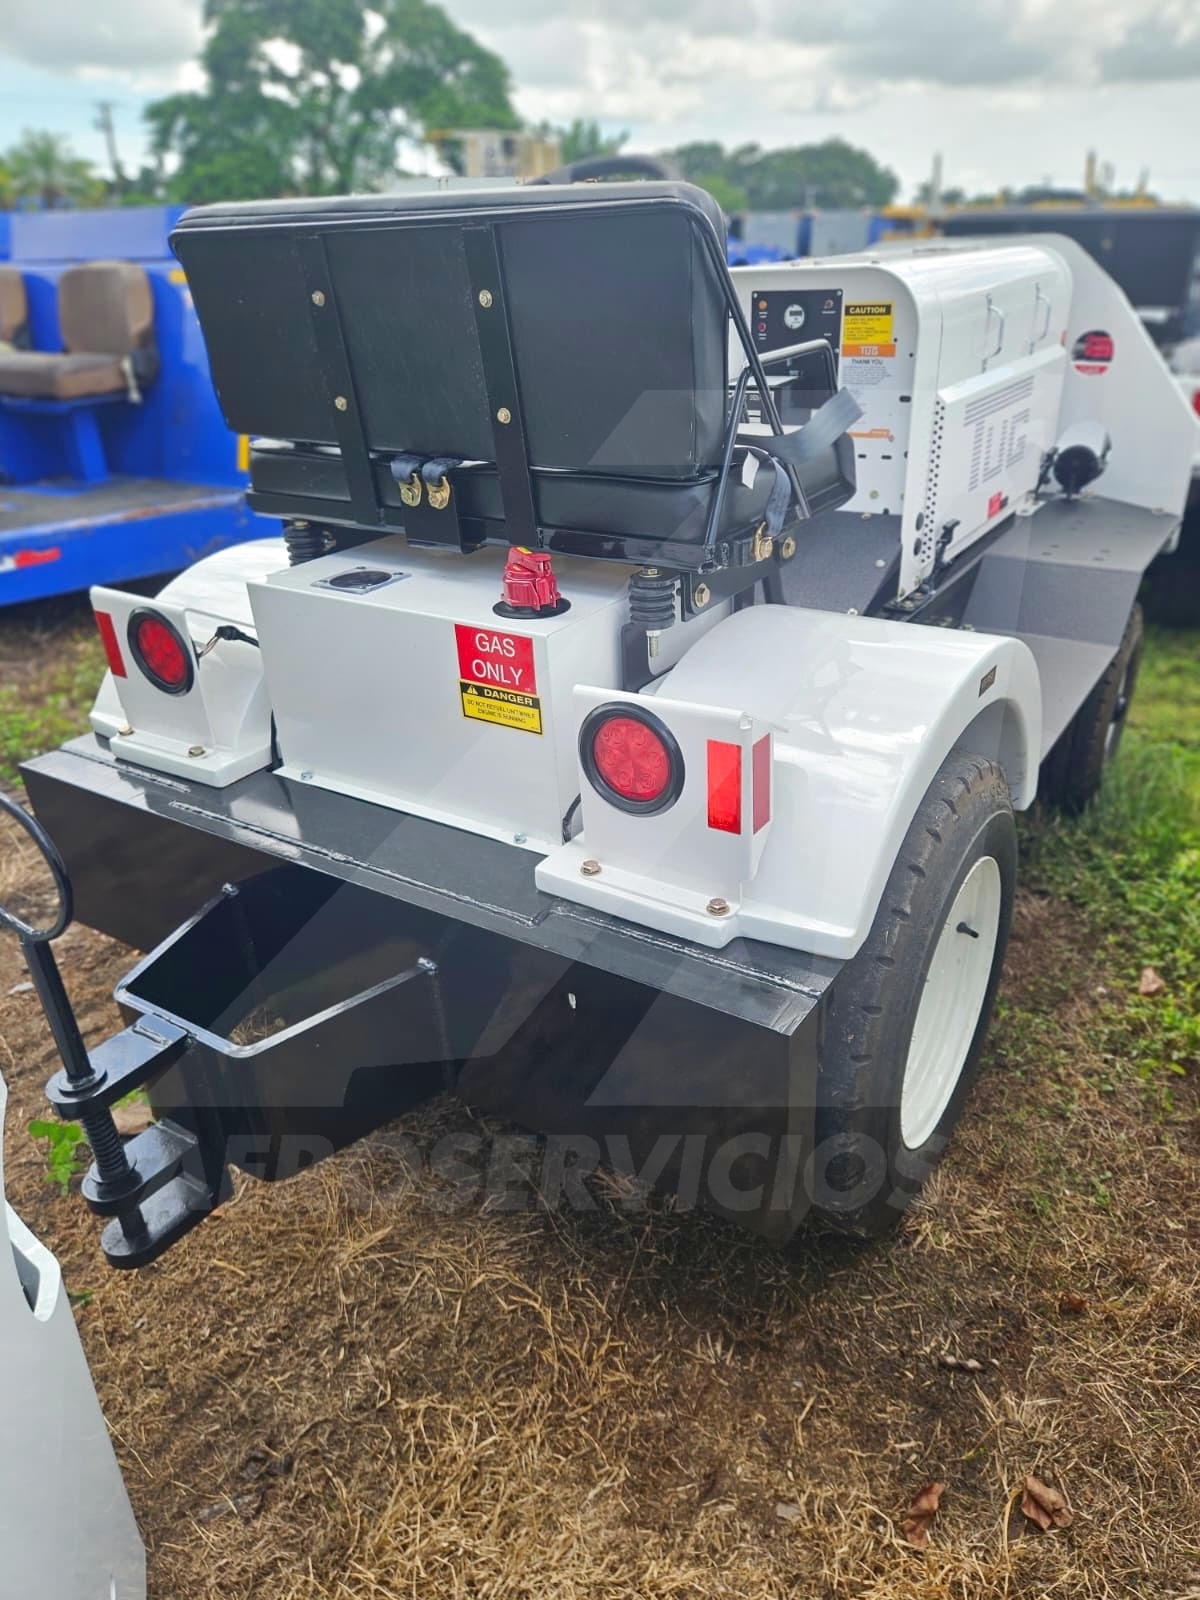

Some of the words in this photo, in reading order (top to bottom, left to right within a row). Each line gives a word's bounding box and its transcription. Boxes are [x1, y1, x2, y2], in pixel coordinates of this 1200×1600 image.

[849, 306, 886, 314] CAUTION
[475, 633, 516, 658] GAS
[472, 659, 523, 686] ONLY
[484, 688, 533, 706] DANGER
